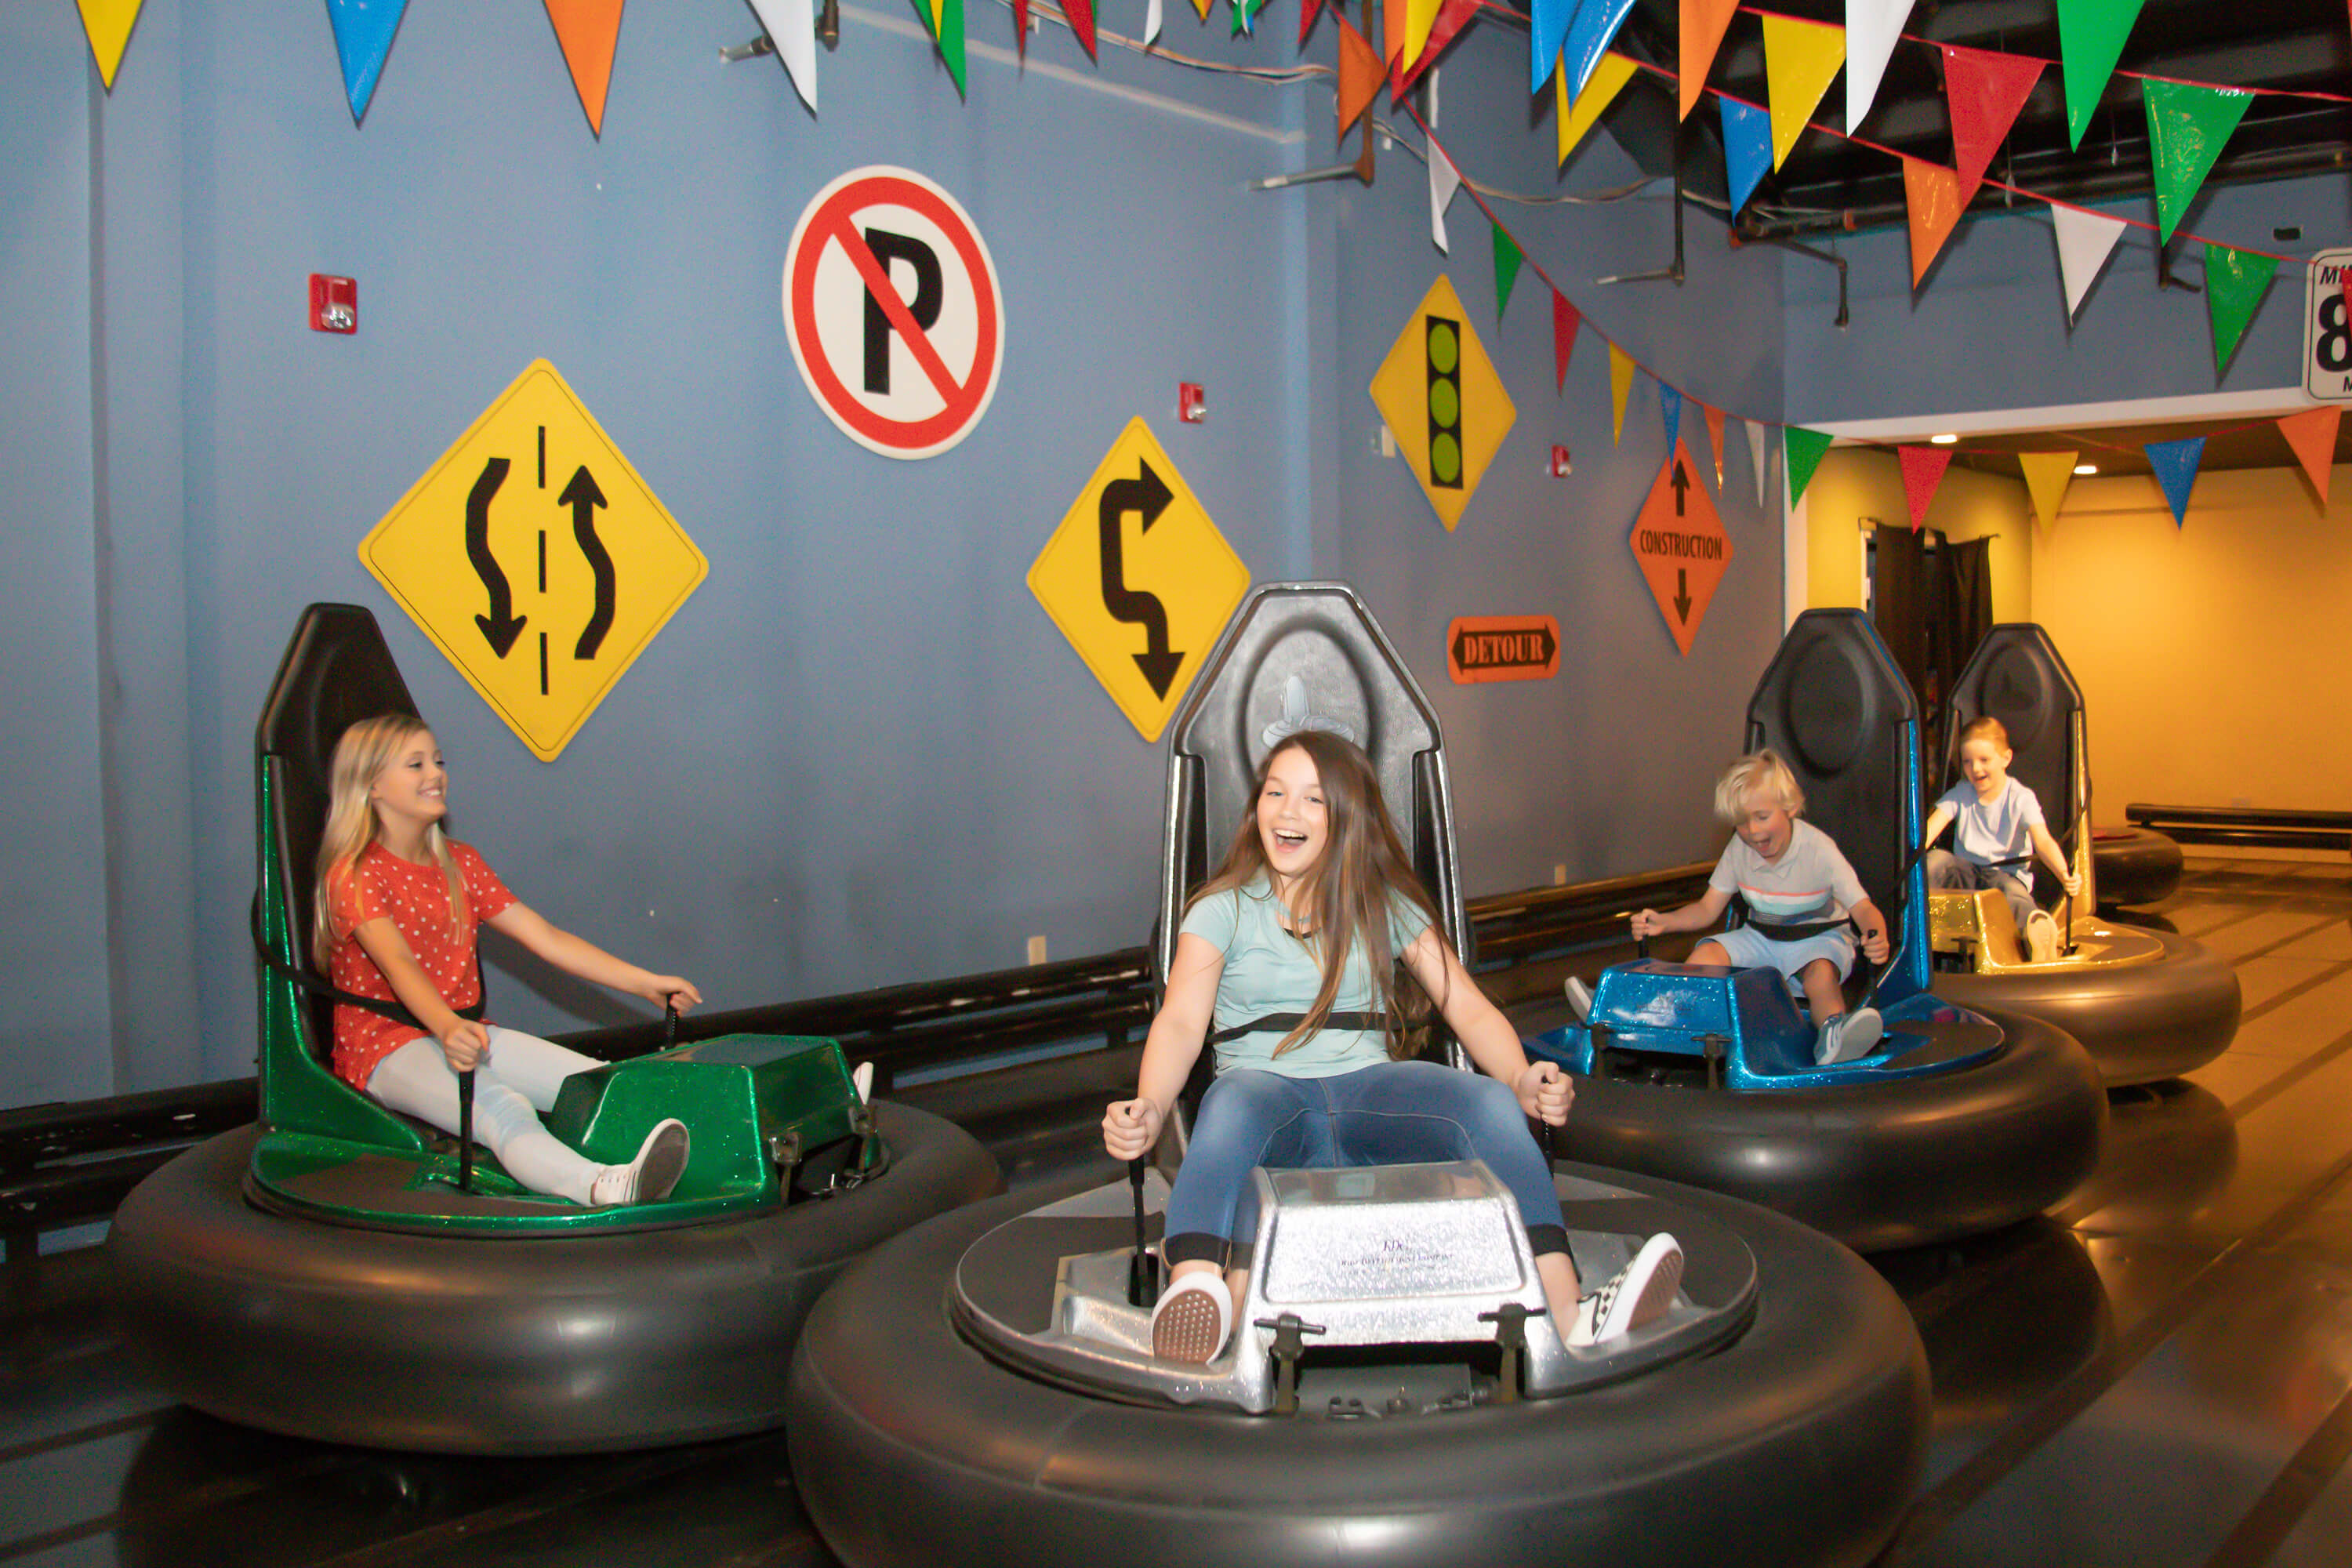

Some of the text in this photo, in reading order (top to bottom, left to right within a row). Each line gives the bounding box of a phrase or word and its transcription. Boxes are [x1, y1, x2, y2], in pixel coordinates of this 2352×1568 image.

[864, 227, 943, 396] P
[1639, 528, 1722, 560] CONSTRUCTION
[1463, 633, 1544, 665] DETOUR
